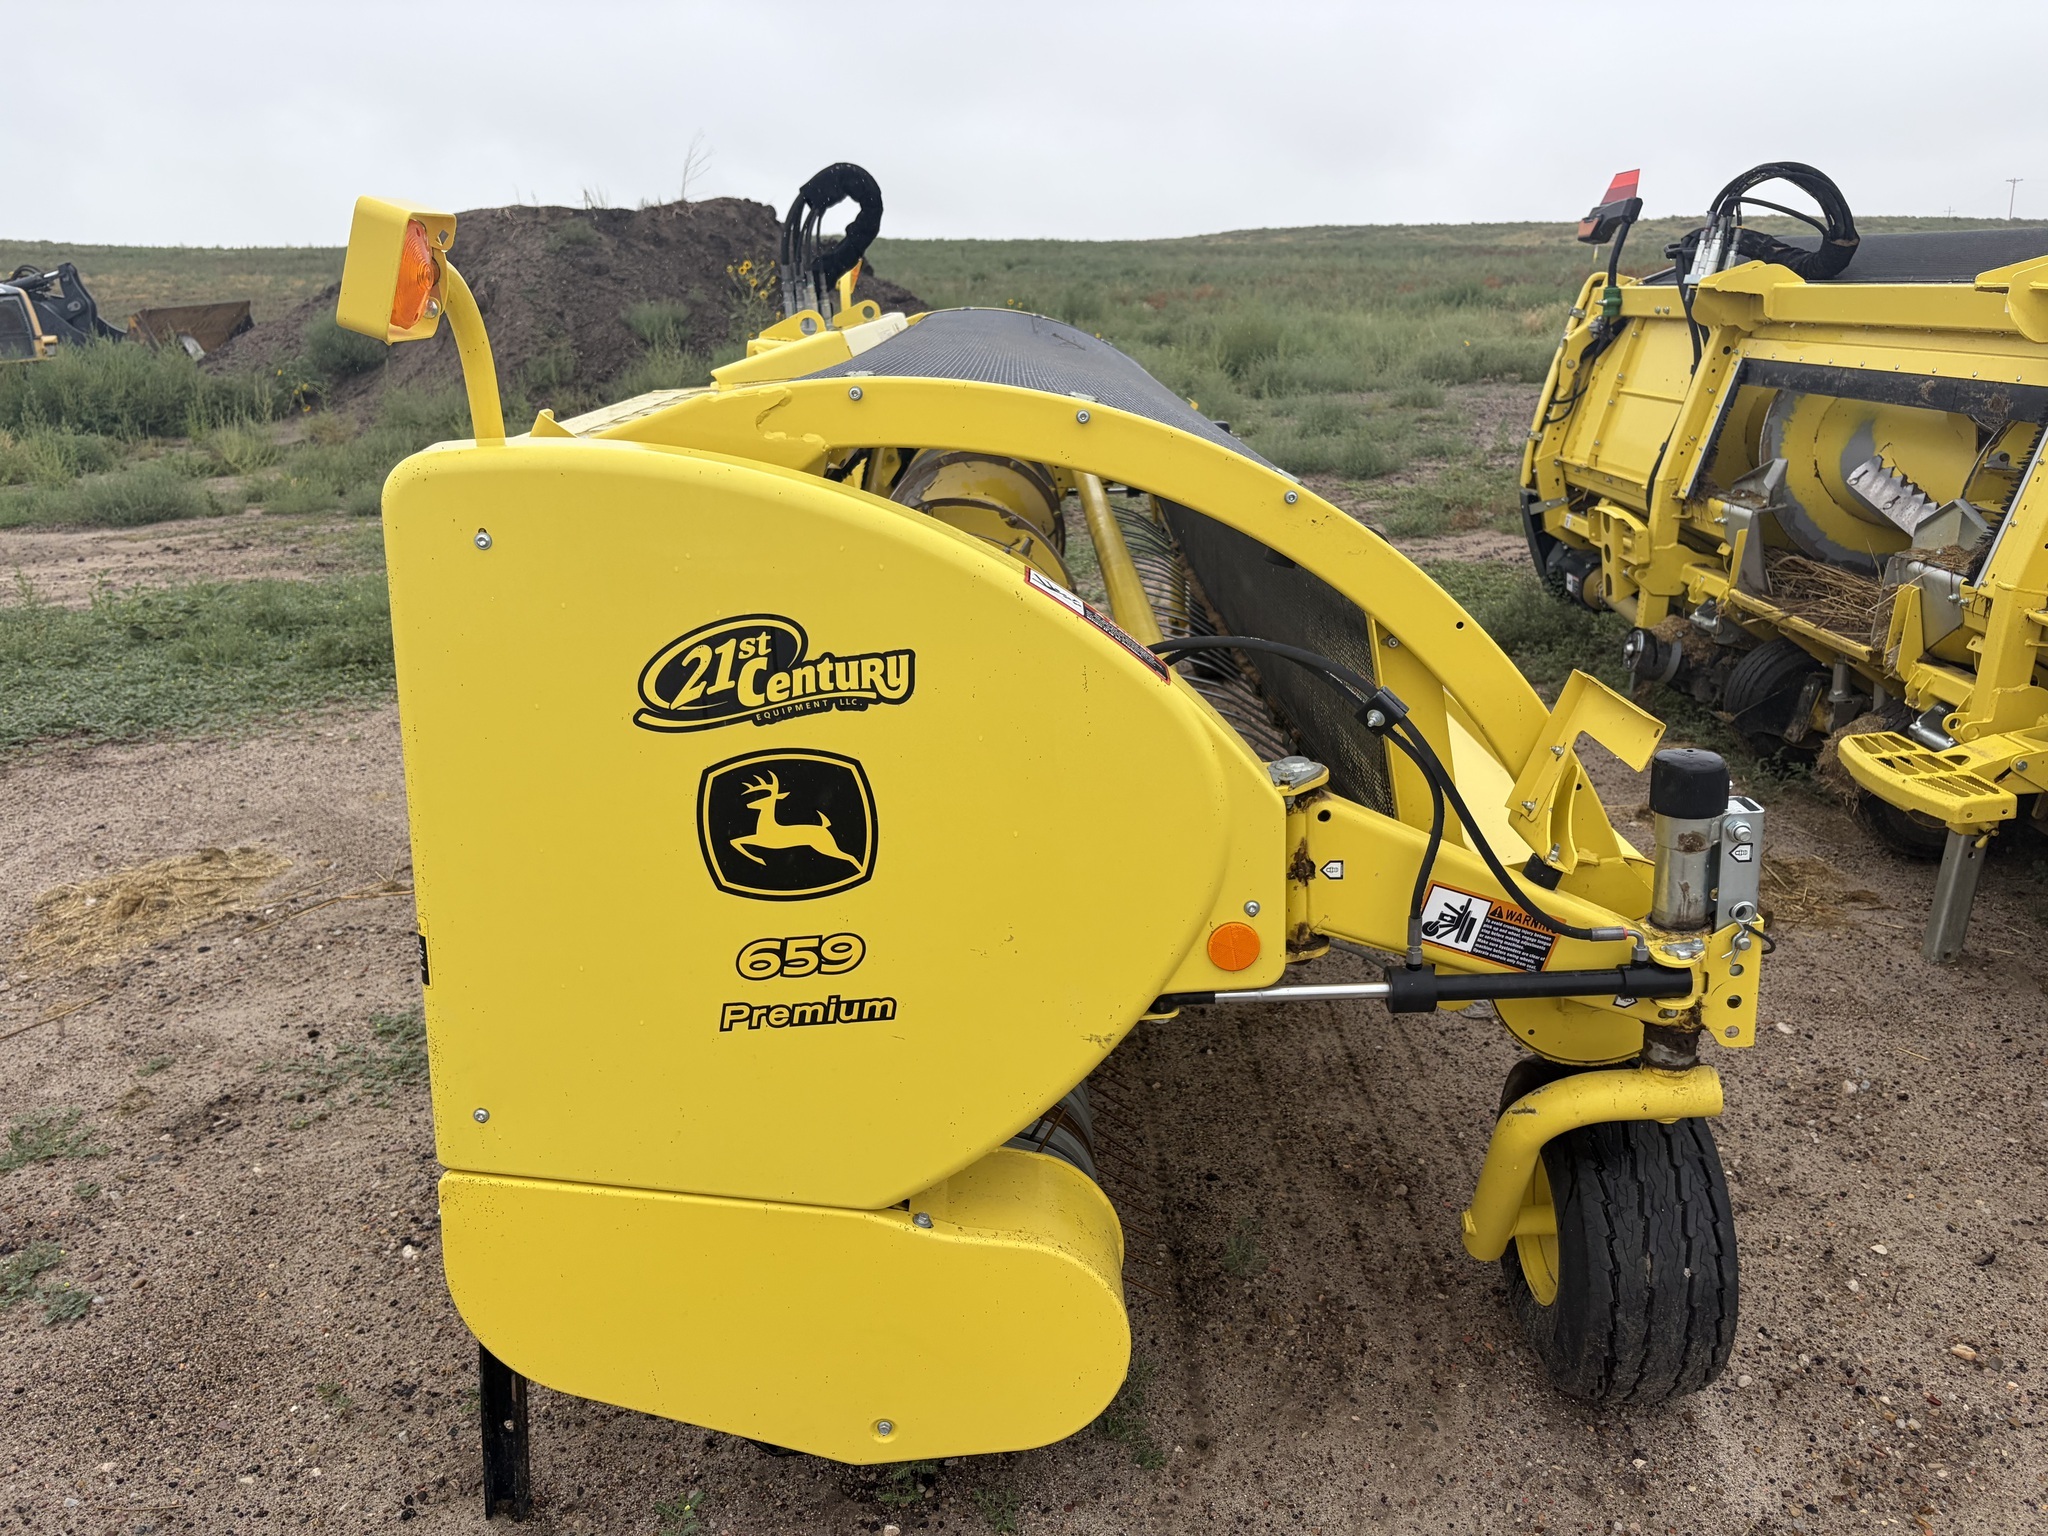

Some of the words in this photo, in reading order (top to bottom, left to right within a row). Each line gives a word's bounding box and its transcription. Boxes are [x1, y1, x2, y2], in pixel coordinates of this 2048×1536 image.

[756, 699, 829, 721] EQUIPMENT
[736, 932, 866, 981] 659
[719, 995, 897, 1032] Premium
